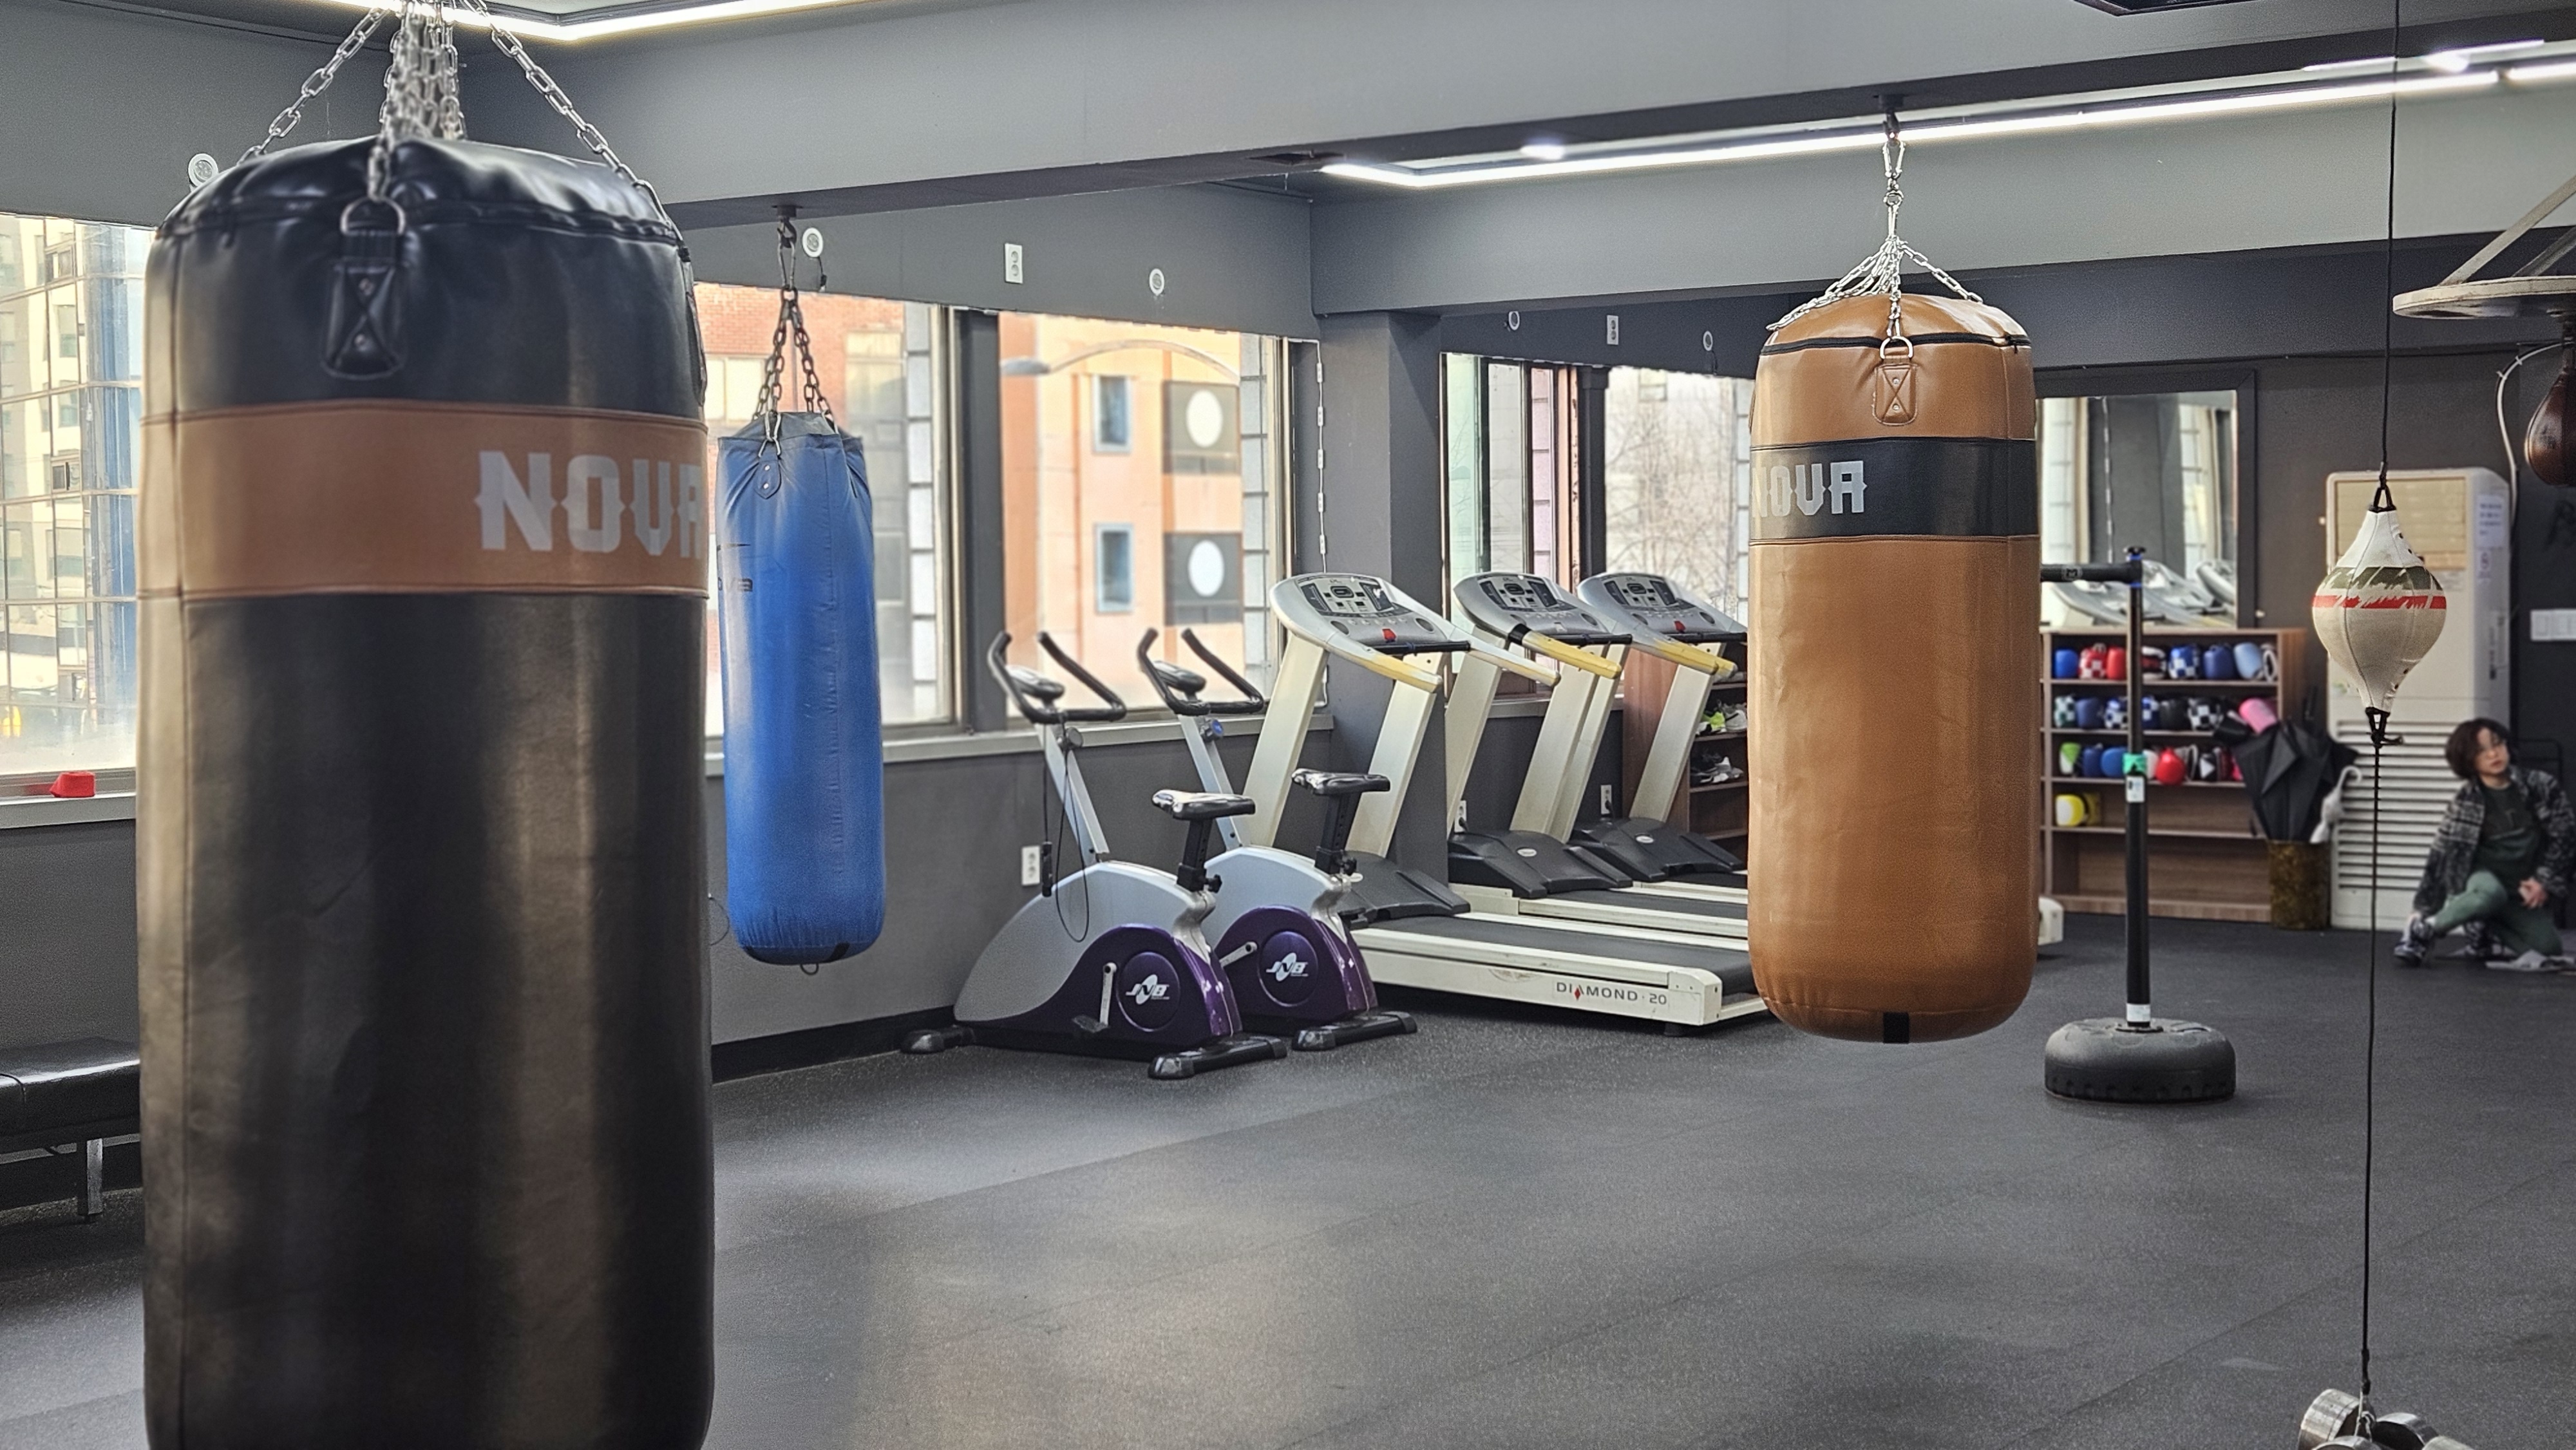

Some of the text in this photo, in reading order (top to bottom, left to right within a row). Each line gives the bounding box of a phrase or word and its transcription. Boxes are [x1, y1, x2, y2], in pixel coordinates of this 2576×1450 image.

[474, 451, 703, 559] NOVA
[1752, 460, 1868, 518] NOVA
[1556, 982, 1667, 1005] DIAMOND 20
